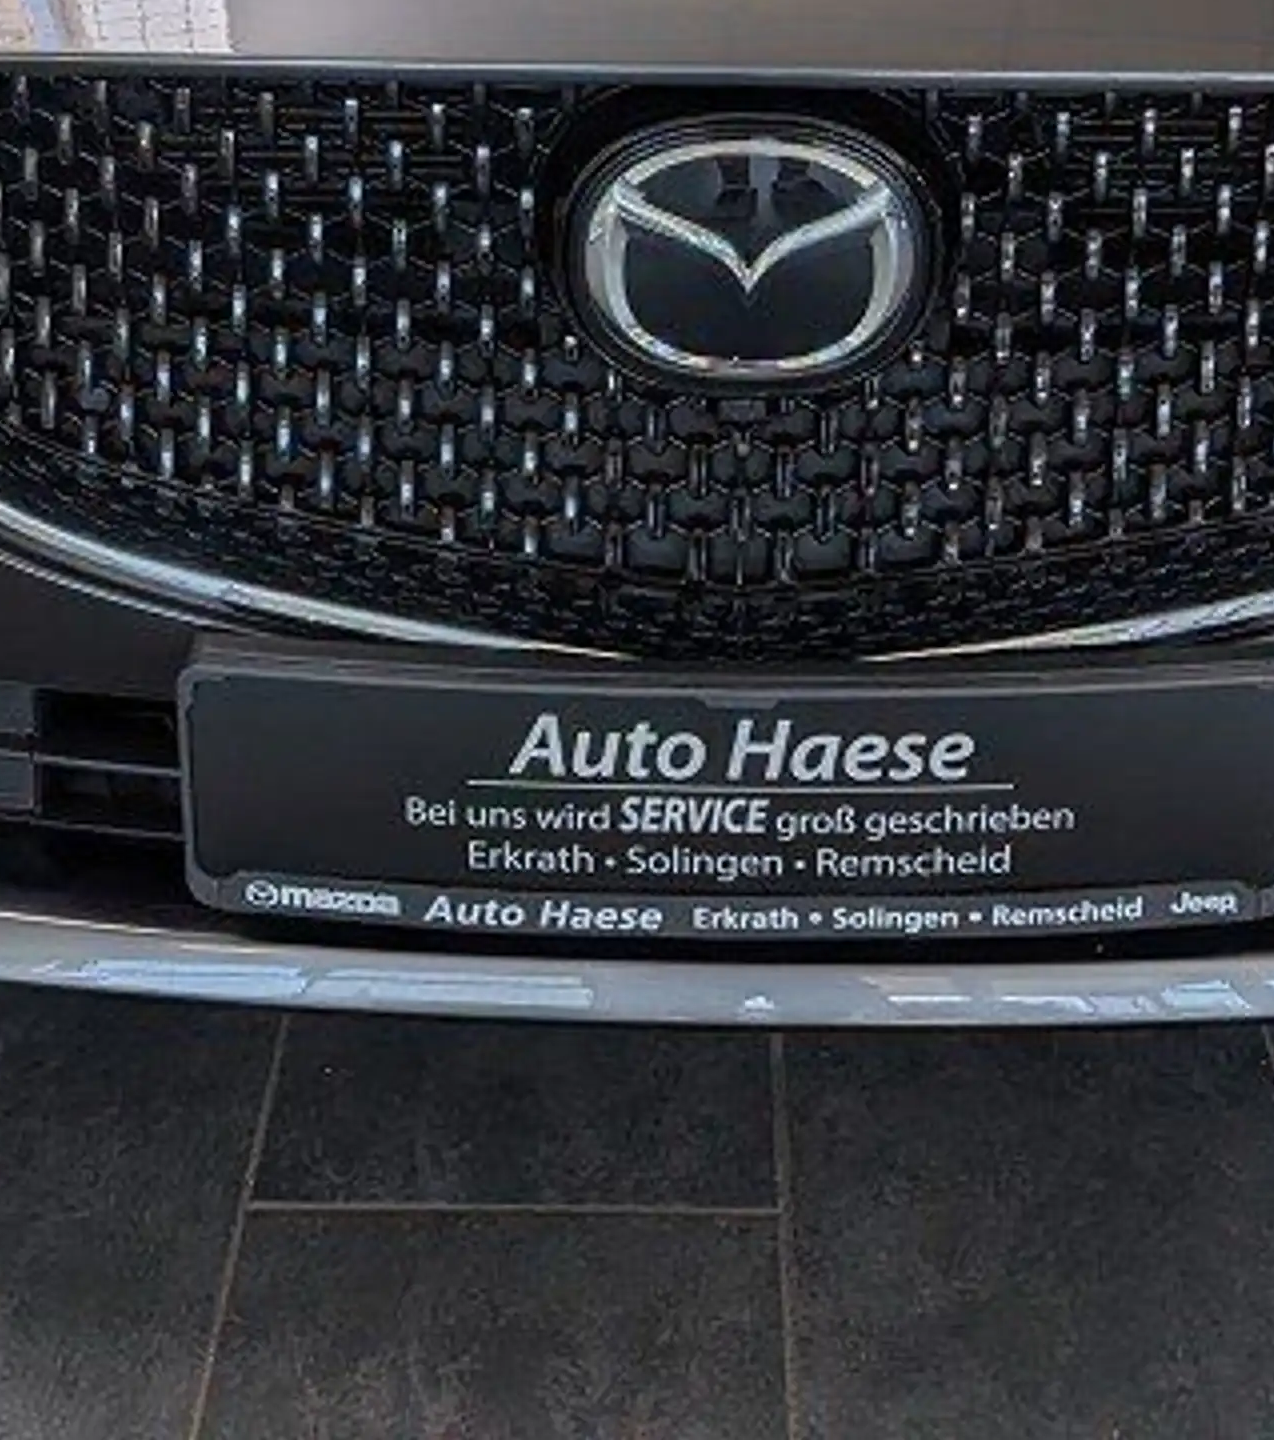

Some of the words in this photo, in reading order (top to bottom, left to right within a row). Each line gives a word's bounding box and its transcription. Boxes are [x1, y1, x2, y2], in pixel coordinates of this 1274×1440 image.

[508, 712, 706, 781] Auto
[725, 719, 975, 782] Haese
[404, 796, 456, 827] Bei
[466, 804, 526, 830] uns
[536, 802, 610, 831] wird
[619, 796, 770, 835] SERVICE
[776, 804, 857, 842] groß
[864, 803, 1076, 843] geschrieben
[467, 839, 595, 874] Erkrath
[625, 843, 783, 882] Solingen
[816, 843, 1012, 878] Remscheid
[424, 894, 526, 927] Auto
[538, 899, 663, 931] Haese
[692, 905, 799, 931] Erkrath
[832, 905, 960, 939] Solingen
[992, 897, 1144, 929] Remscheid
[1170, 890, 1239, 917] Jeep
